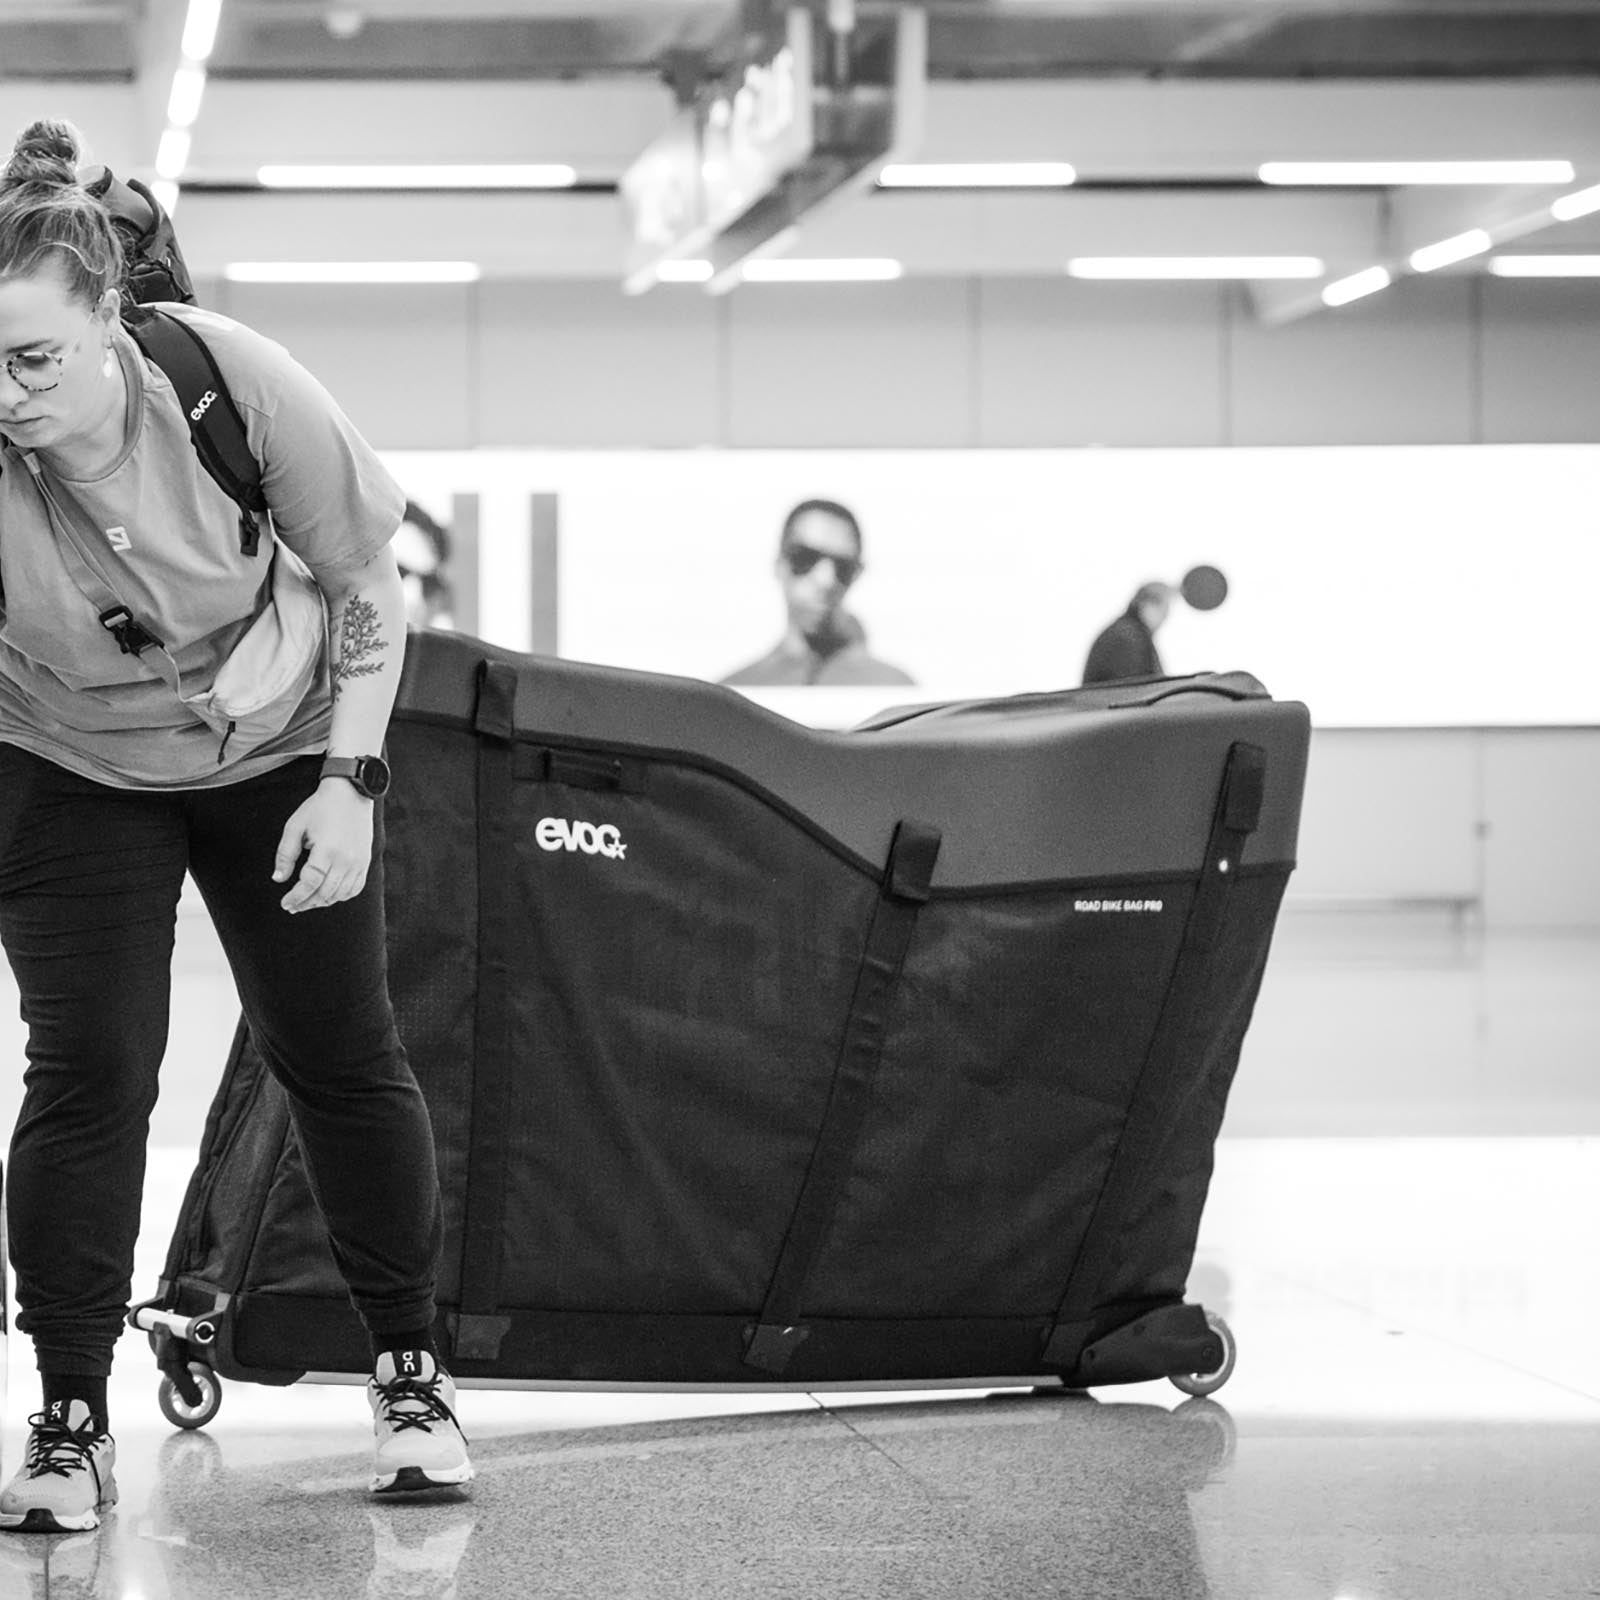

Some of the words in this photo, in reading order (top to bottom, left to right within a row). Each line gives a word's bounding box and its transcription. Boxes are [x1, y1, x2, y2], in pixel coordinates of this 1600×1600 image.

[535, 817, 626, 860] evoc
[1074, 900, 1101, 912] ROAD
[1102, 900, 1122, 912] BIKE
[1123, 900, 1143, 912] BAG
[1143, 900, 1163, 912] PRO
